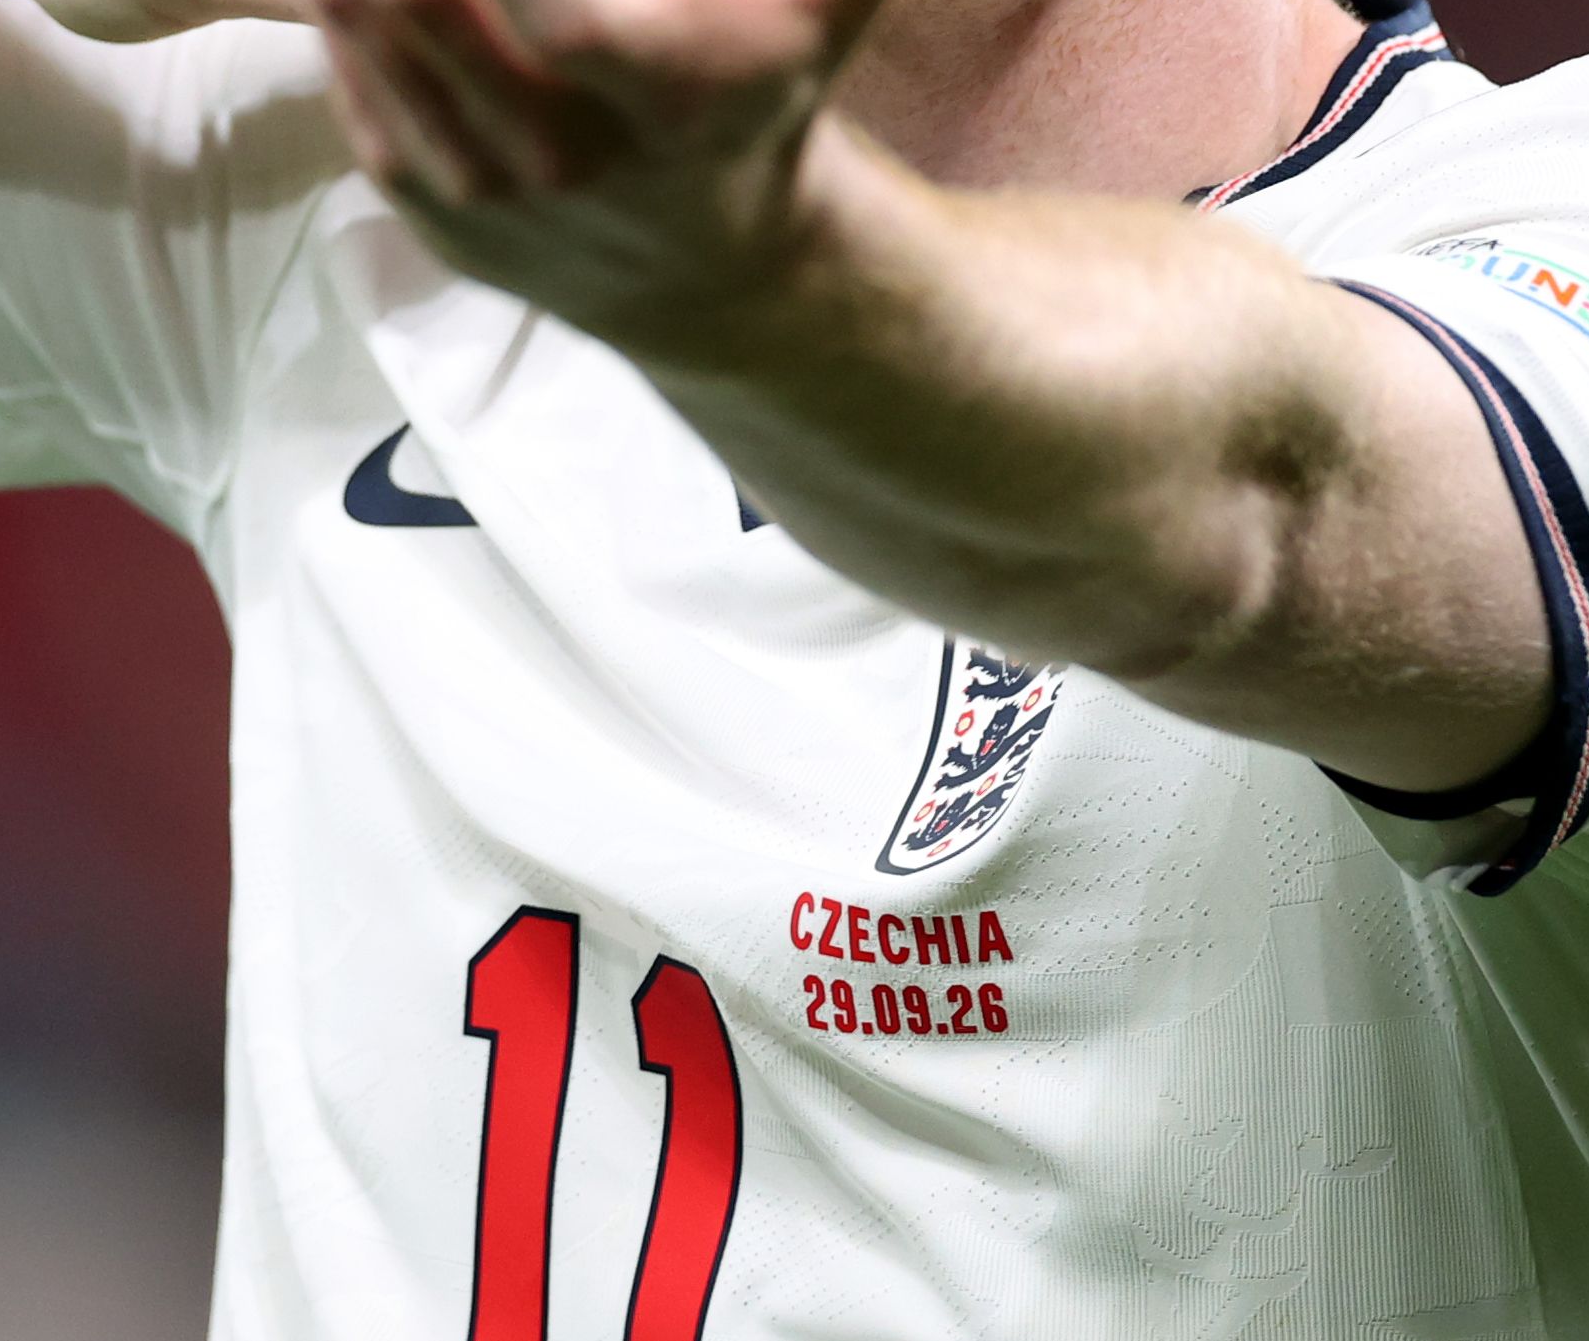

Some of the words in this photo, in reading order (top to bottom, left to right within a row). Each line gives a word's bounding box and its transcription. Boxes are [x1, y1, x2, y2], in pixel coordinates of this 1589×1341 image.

[789, 891, 1014, 966] CZECHIA
[803, 974, 1009, 1035] 29.09.26
[463, 904, 744, 1341] 11
